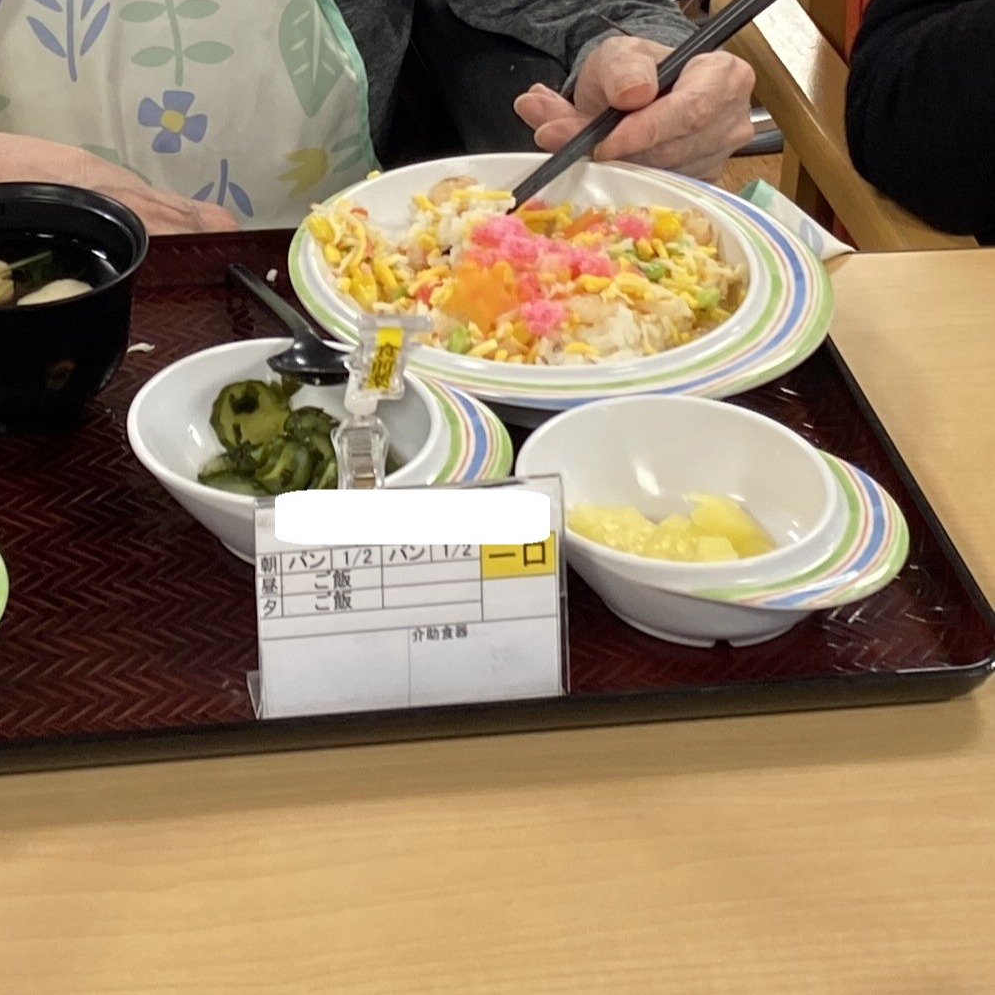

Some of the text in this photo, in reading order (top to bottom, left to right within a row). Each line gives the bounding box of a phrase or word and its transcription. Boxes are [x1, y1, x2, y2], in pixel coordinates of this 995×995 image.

[261, 554, 277, 573] 朝
[344, 549, 373, 566] 1/2
[444, 544, 472, 559] 1/2
[262, 569, 352, 594] 昼 ご飯
[314, 590, 352, 611] ご飯
